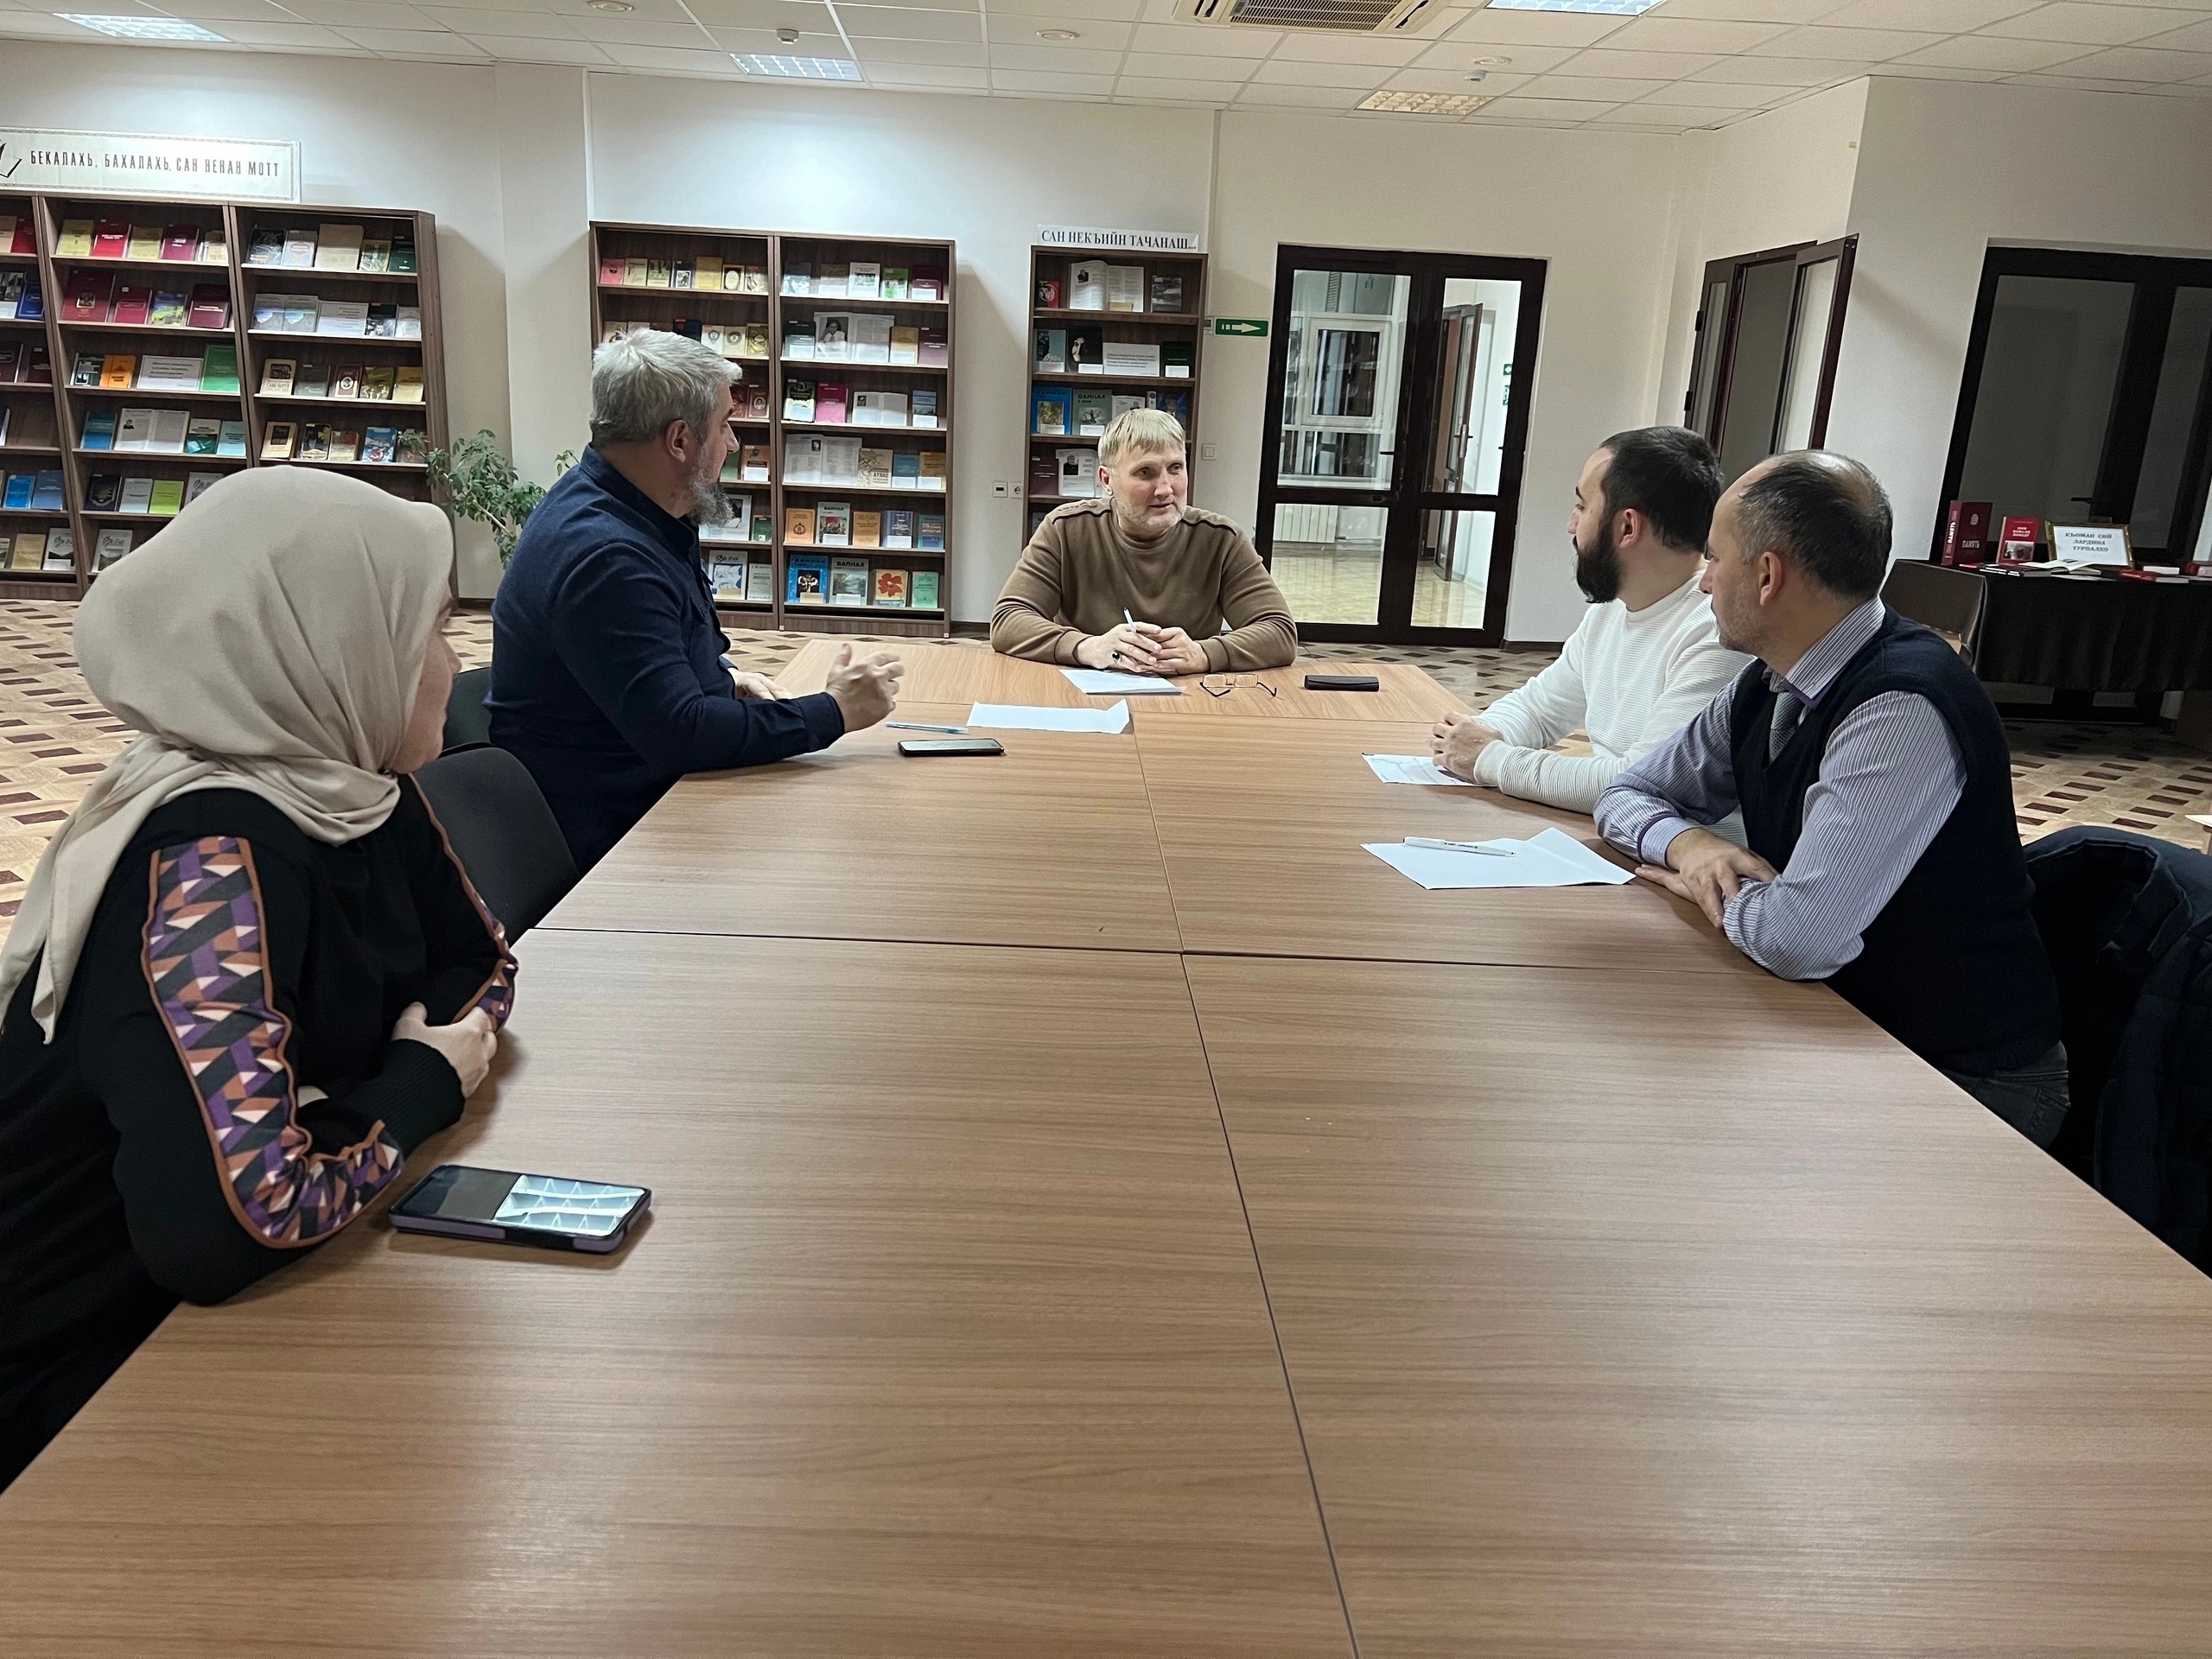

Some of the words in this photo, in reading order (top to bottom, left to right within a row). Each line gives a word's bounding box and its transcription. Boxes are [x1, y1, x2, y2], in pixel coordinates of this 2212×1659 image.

[176, 157, 198, 172] САН
[205, 159, 241, 175] НЕНАН
[248, 162, 278, 177] МОТТ
[1041, 230, 1065, 243] САН
[1068, 231, 1127, 246] НЕКЪИЙН
[1129, 235, 1197, 250] ТАЧАНАШ...
